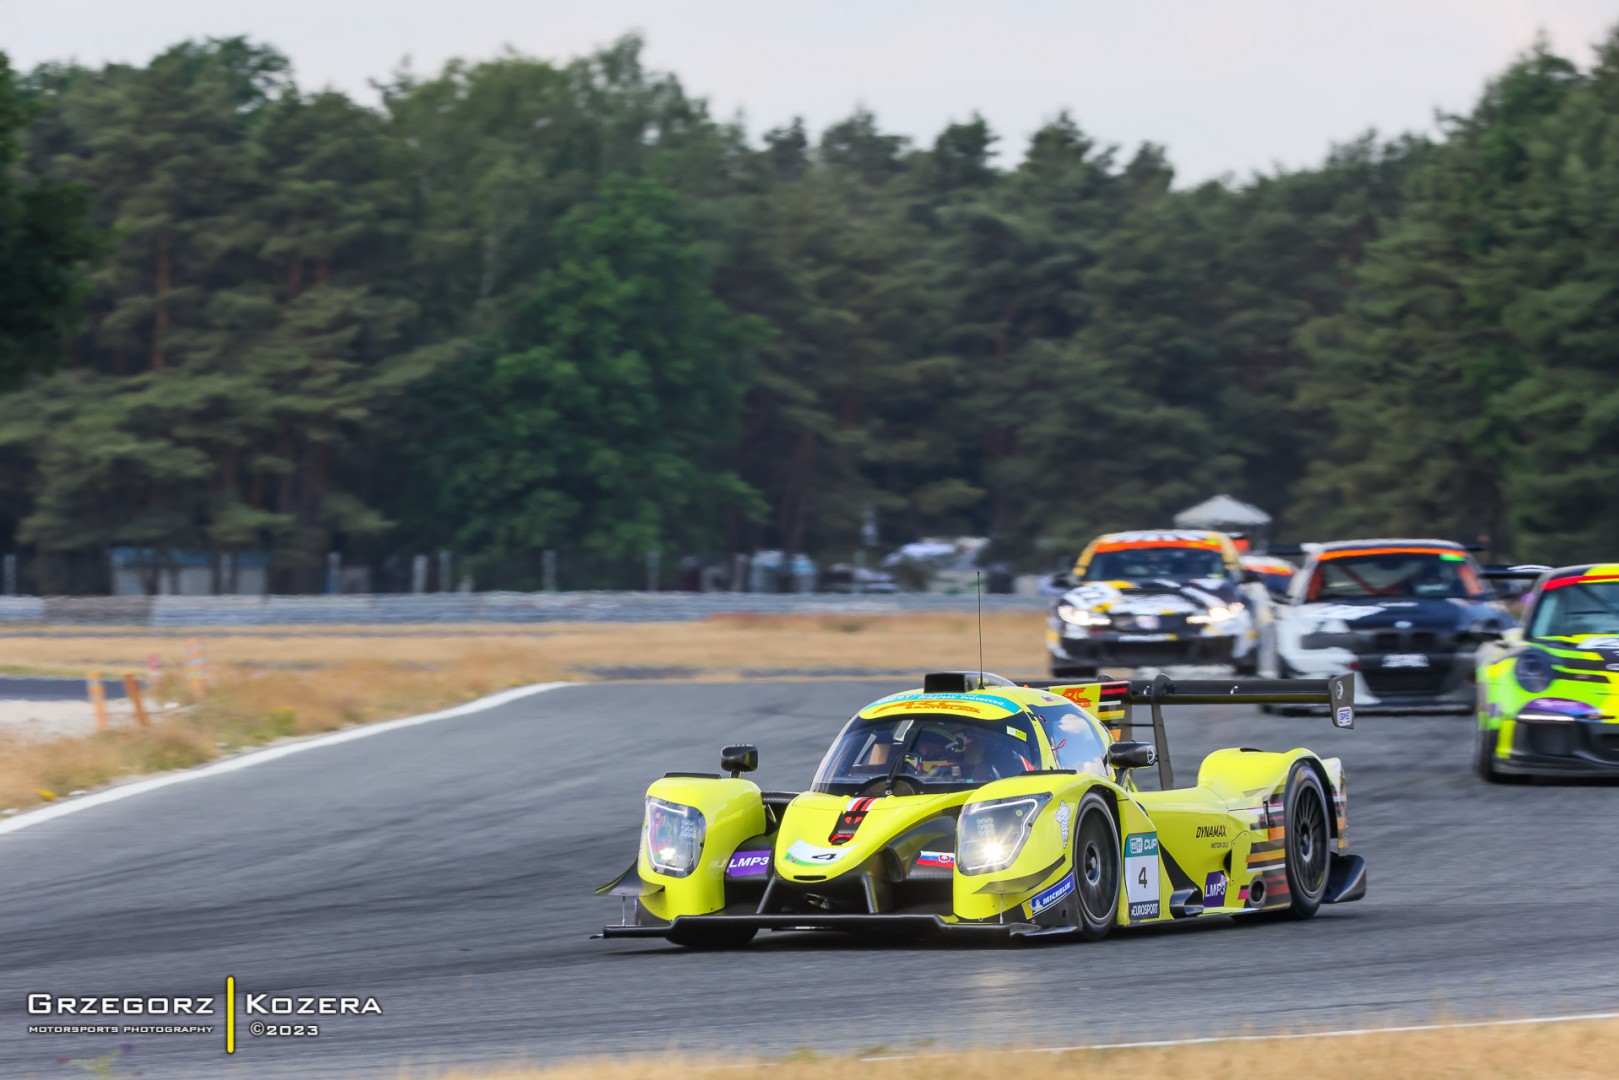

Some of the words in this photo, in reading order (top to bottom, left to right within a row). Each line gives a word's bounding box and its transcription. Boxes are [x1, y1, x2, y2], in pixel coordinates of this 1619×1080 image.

[1196, 825, 1227, 838] DYNAMAX
[1144, 838, 1157, 850] CUP
[728, 856, 769, 868] LMP3
[1138, 867, 1147, 889] 4
[1042, 881, 1071, 905] MICHELIN
[1205, 883, 1226, 897] LMP3
